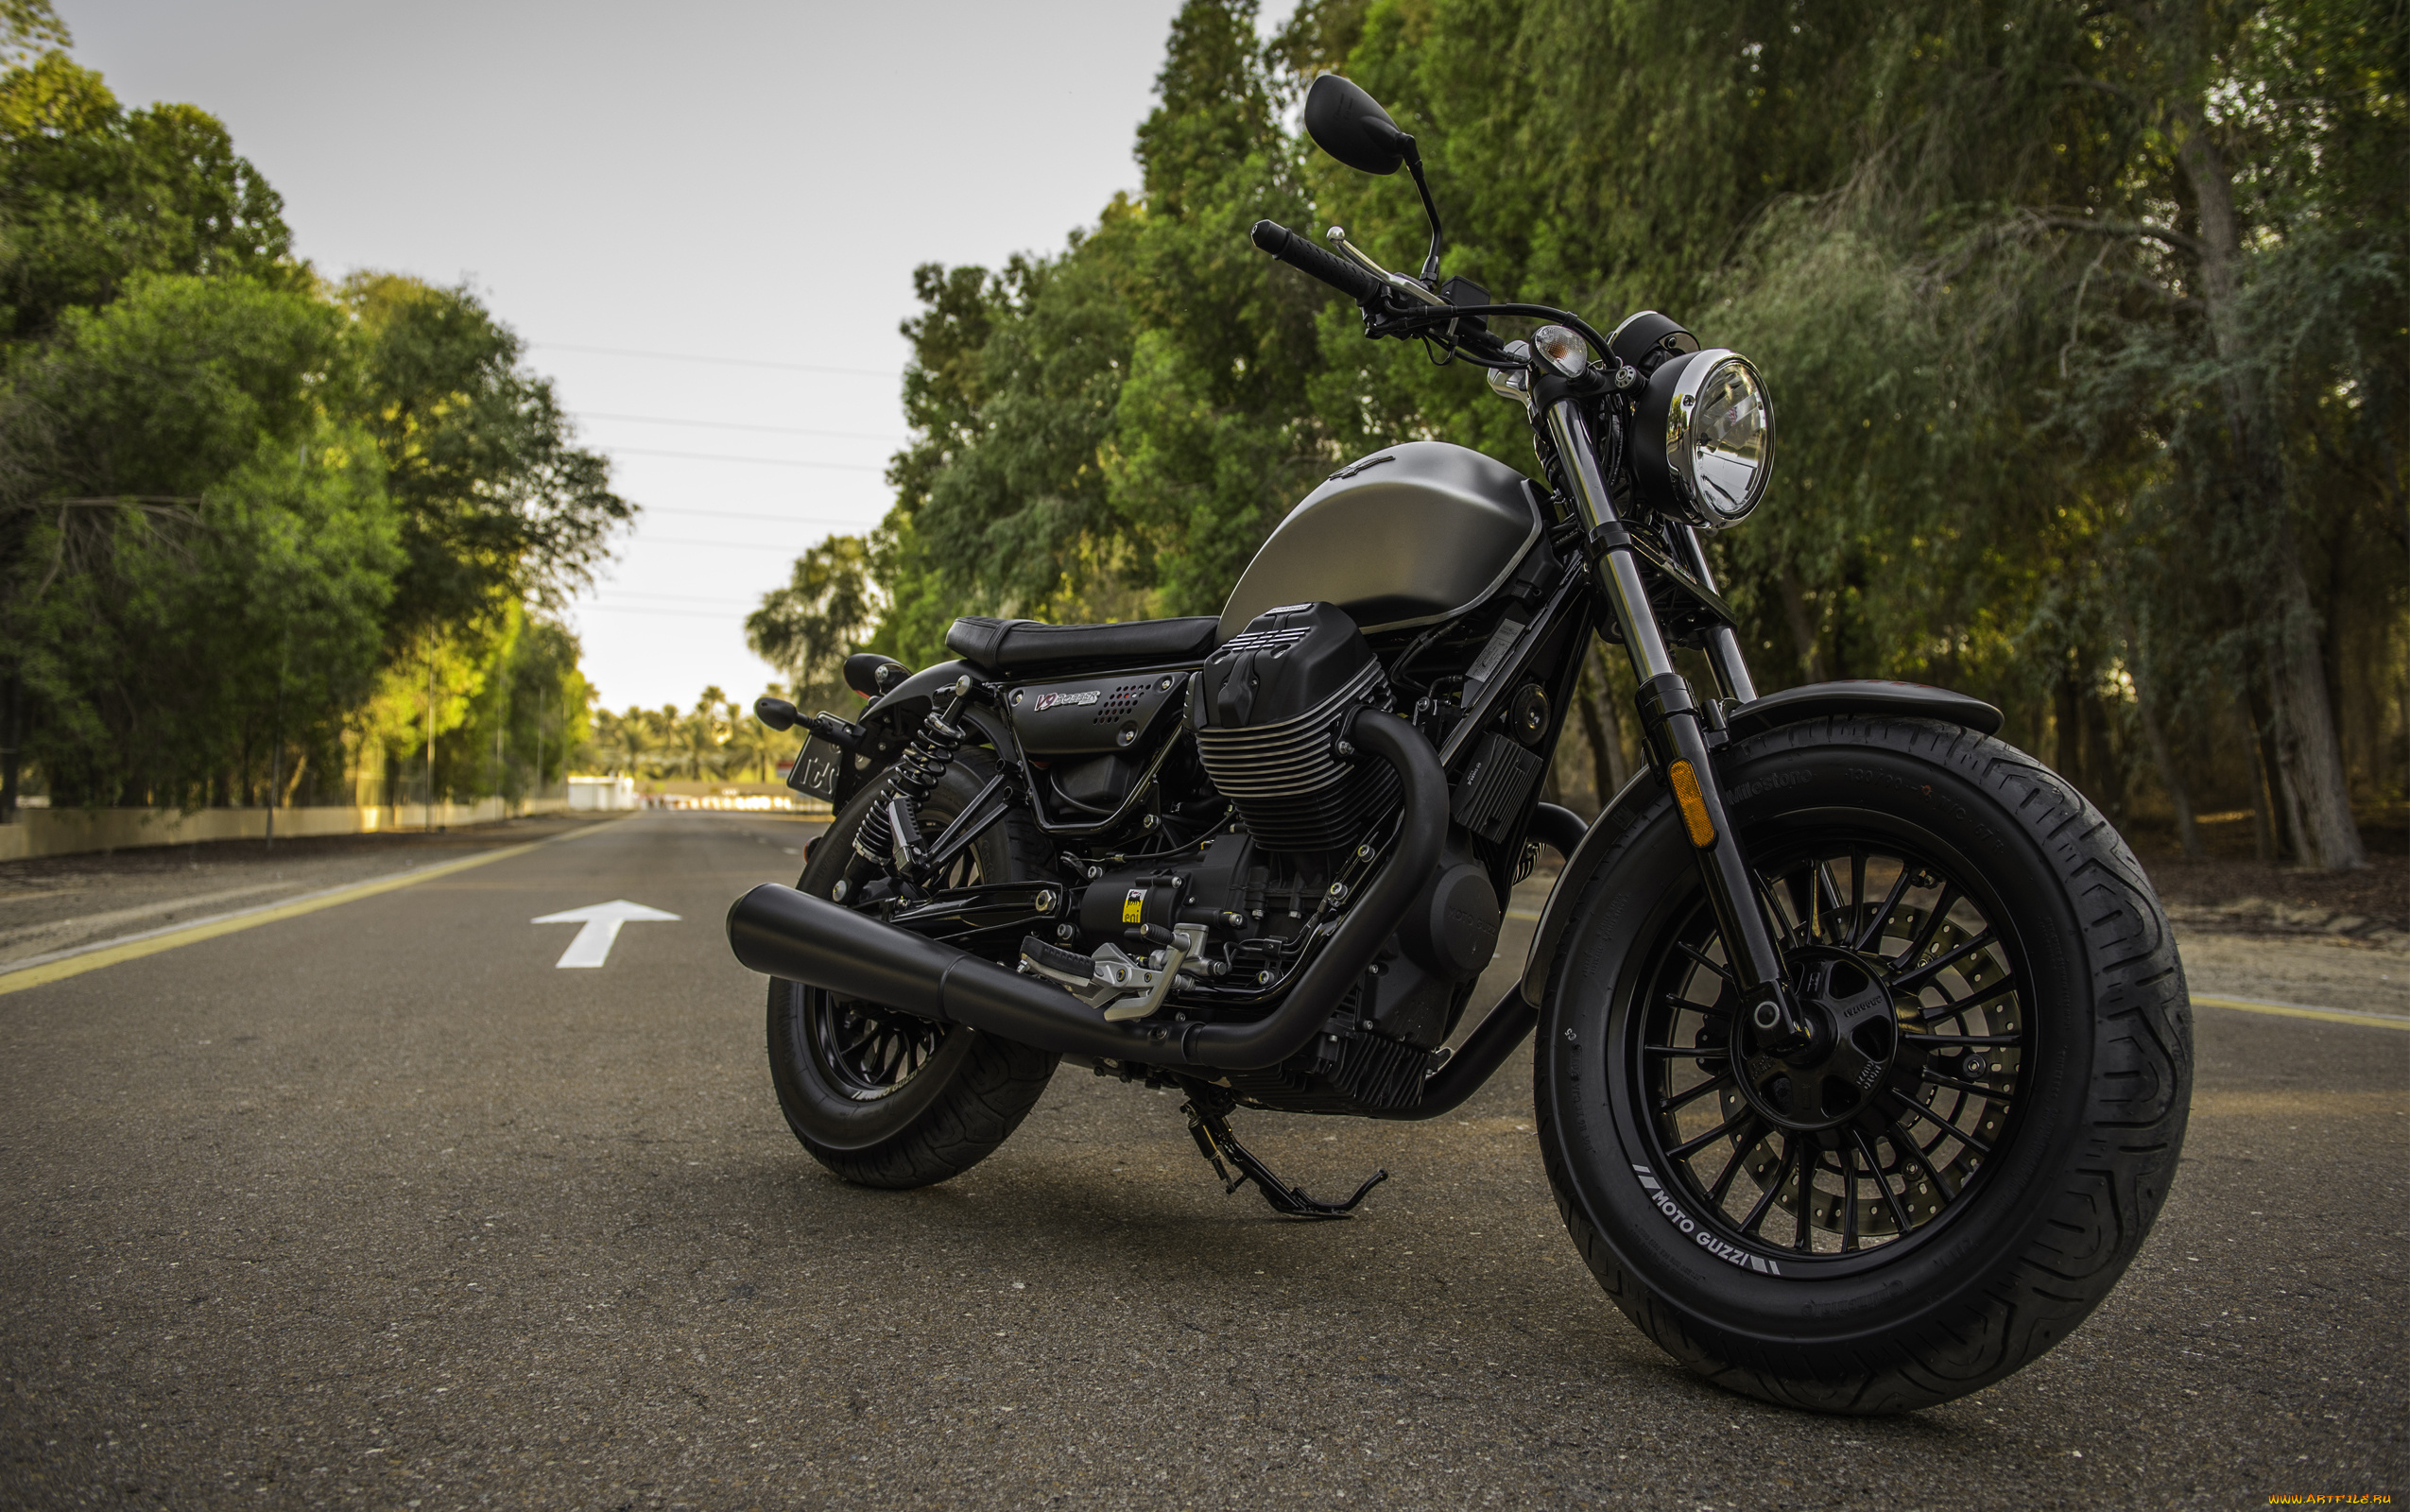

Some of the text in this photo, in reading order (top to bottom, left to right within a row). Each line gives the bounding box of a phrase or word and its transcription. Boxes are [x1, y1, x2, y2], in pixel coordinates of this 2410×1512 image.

[1034, 693, 1058, 712] V9
[1124, 909, 1140, 923] eni
[1652, 1190, 1695, 1233] MOTO
[1696, 1231, 1749, 1266] GUZZI
